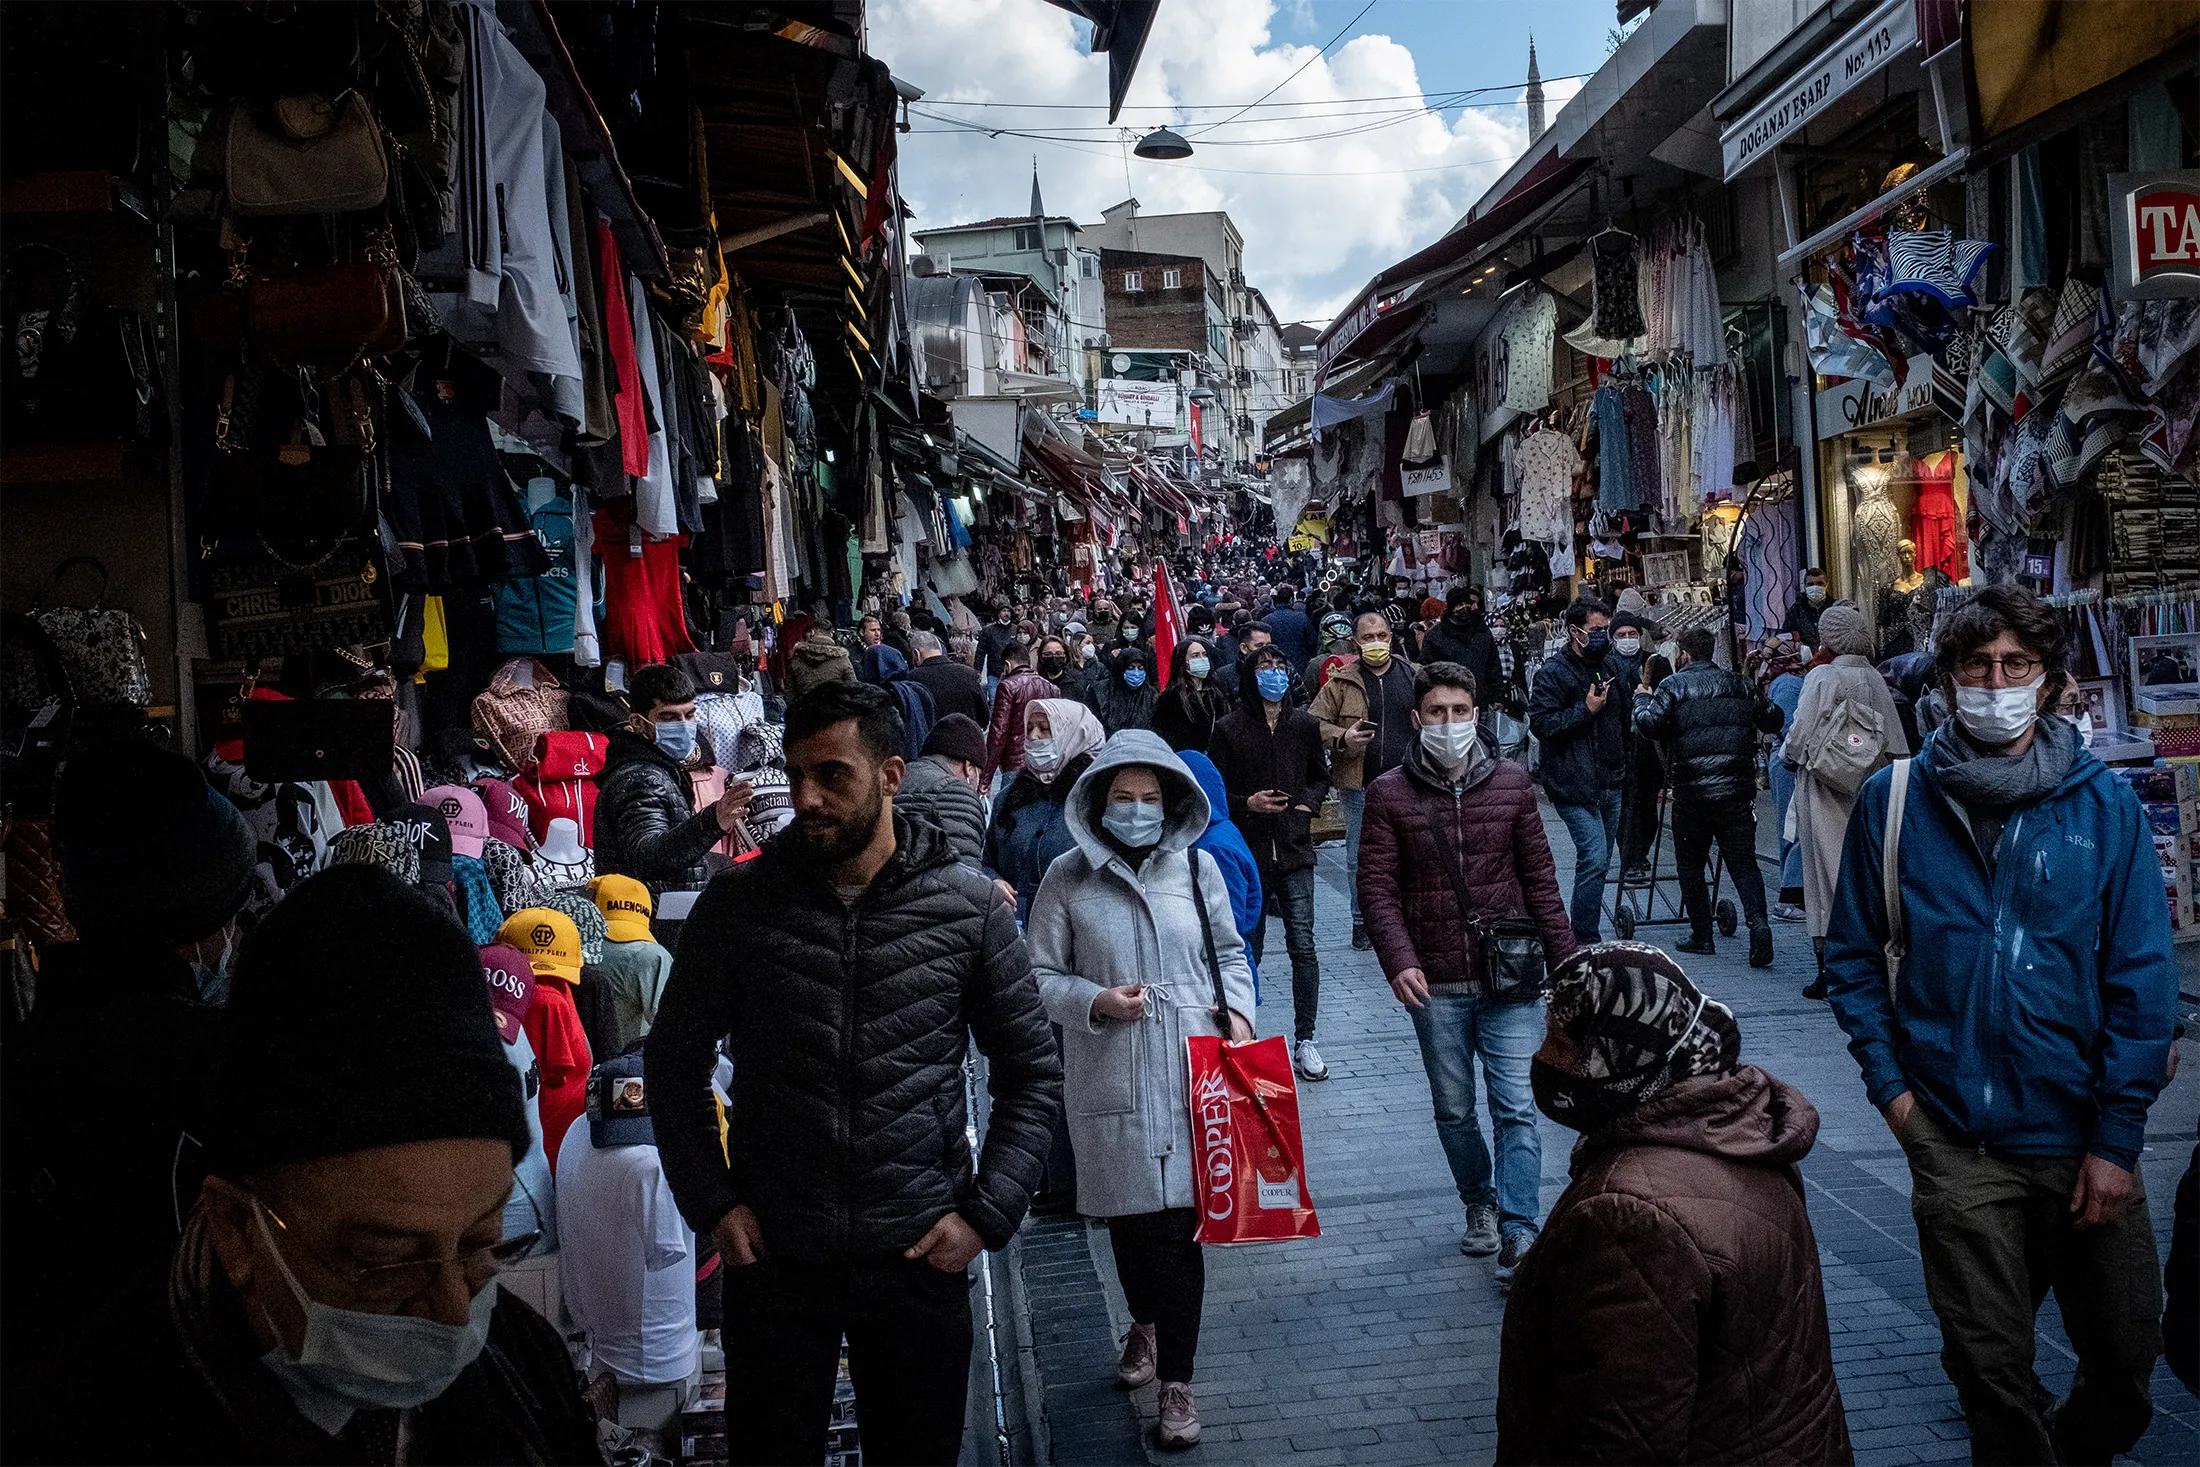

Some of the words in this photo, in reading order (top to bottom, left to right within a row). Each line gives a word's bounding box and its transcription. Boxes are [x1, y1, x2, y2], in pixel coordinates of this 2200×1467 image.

[1740, 103, 1790, 159] DOĞANAY
[1793, 72, 1831, 116] EŞARP
[1845, 51, 1865, 80] No:
[1867, 27, 1891, 61] 113
[2028, 558, 2042, 574] 15
[330, 581, 374, 604] DIOR
[1202, 1073, 1232, 1220] COOPER
[1261, 1188, 1292, 1197] COOPER
